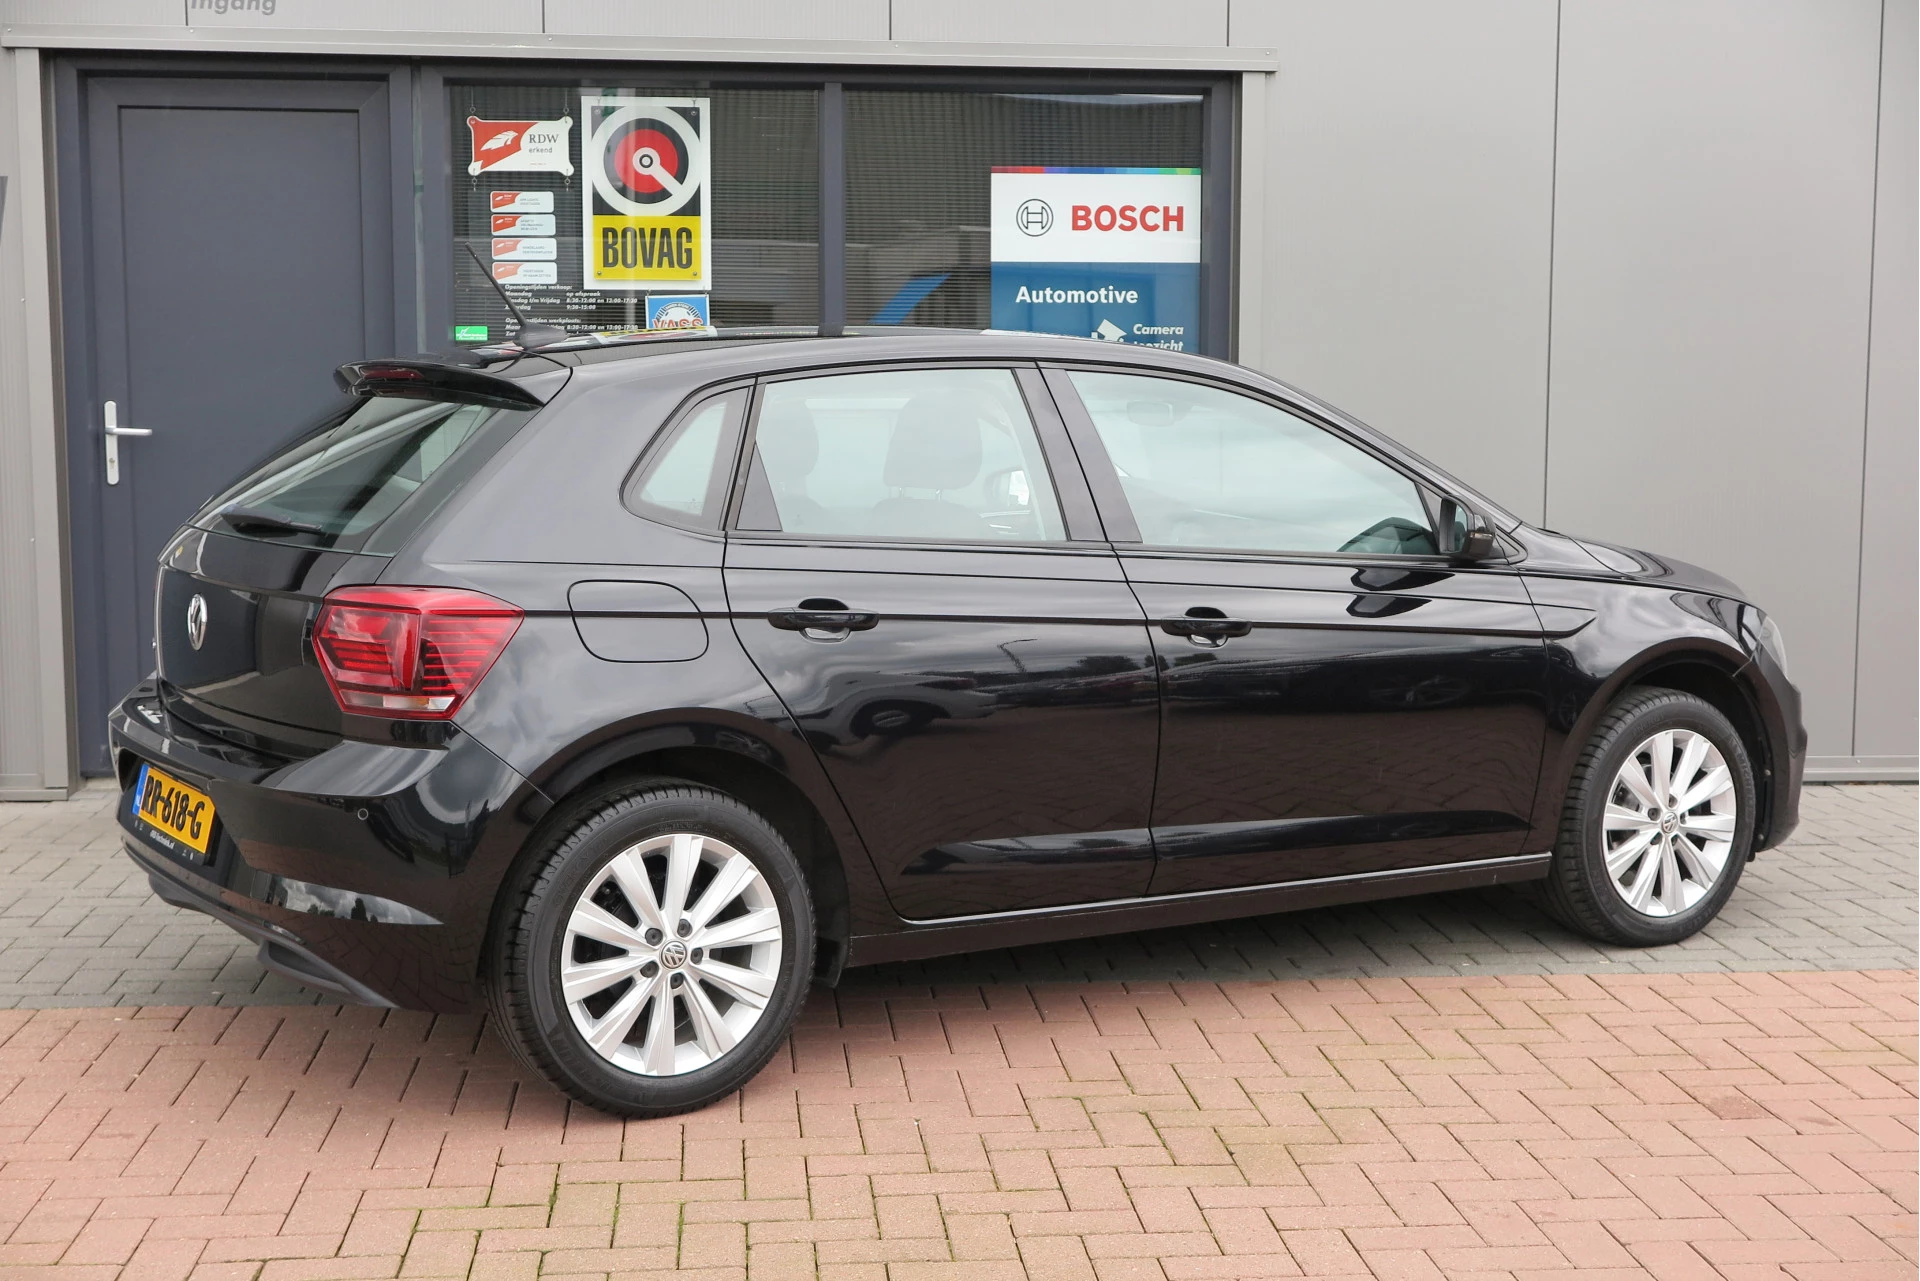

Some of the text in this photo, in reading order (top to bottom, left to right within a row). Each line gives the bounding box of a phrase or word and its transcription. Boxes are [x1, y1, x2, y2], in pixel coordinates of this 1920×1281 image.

[529, 133, 559, 144] RDW
[529, 146, 553, 154] erkend
[1071, 204, 1184, 232] BOSCH
[602, 226, 693, 269] BOVAG
[1015, 285, 1139, 304] Automotive
[1133, 323, 1184, 335] Camera
[141, 774, 206, 840] RR-618-G
